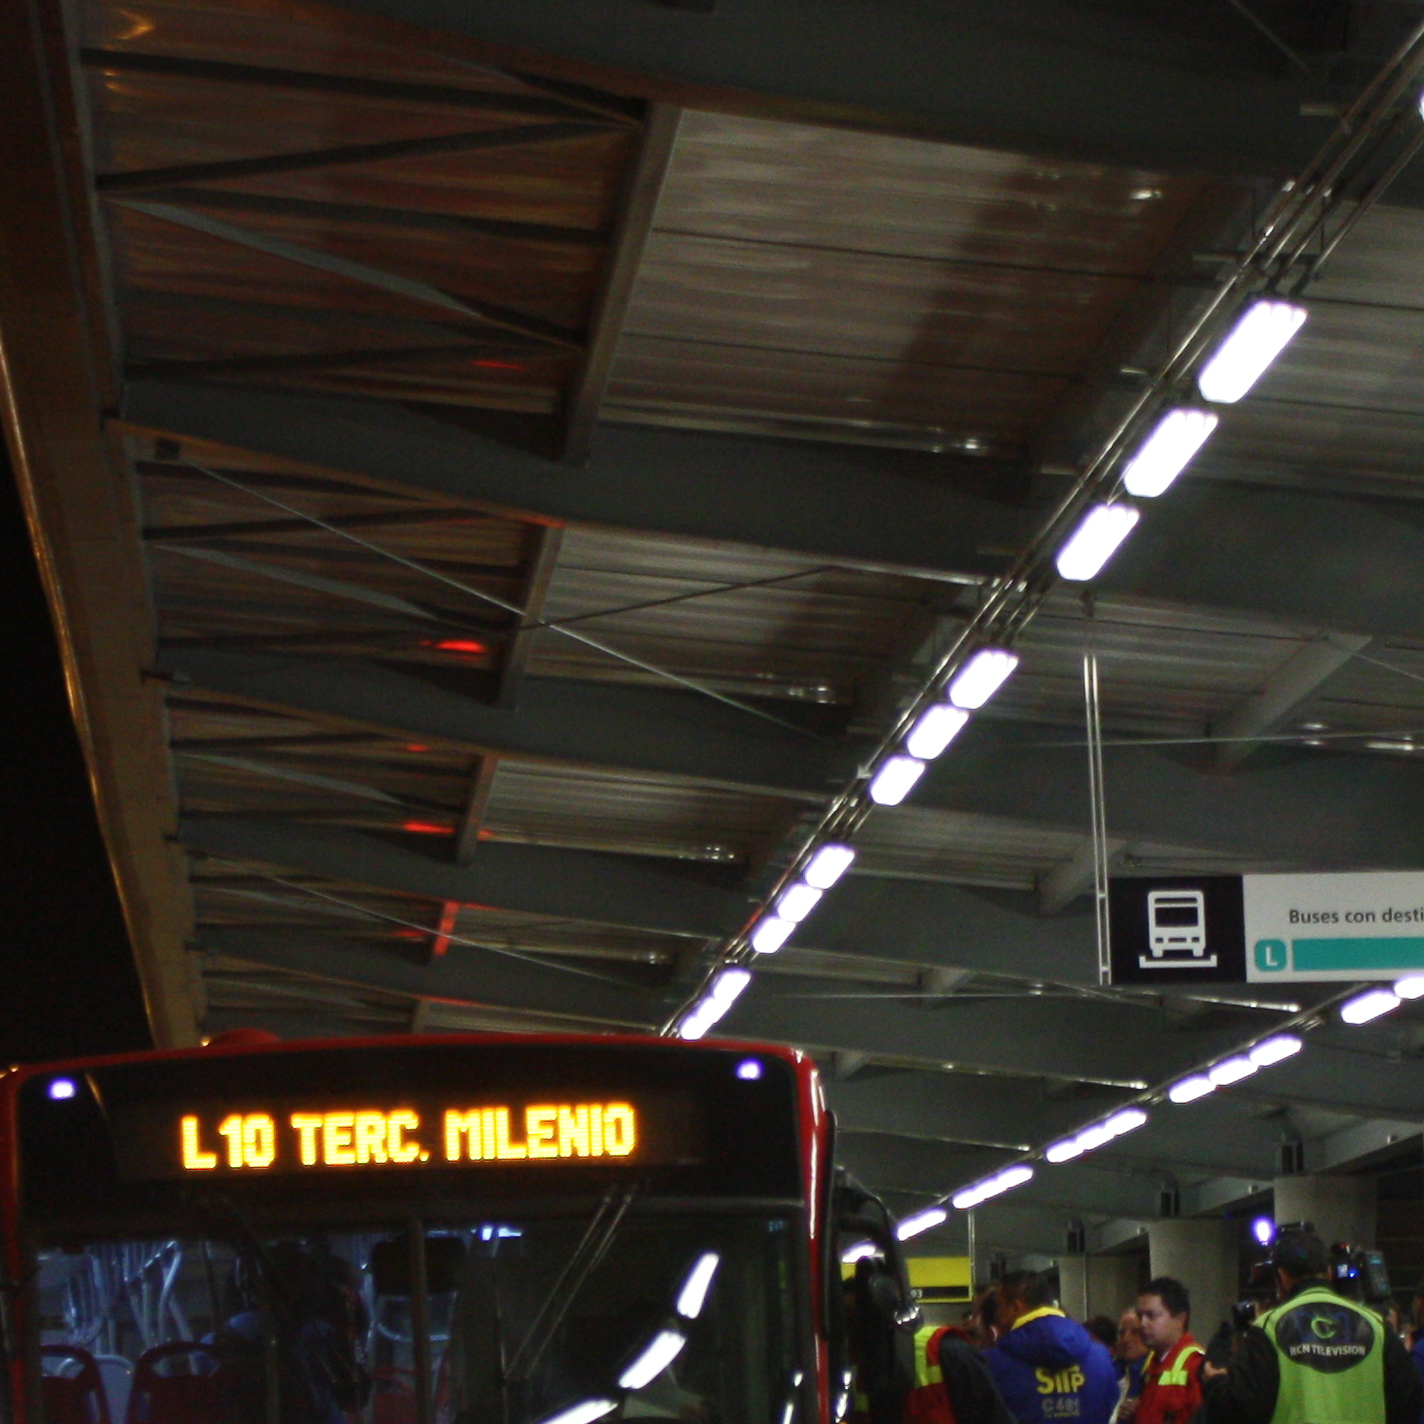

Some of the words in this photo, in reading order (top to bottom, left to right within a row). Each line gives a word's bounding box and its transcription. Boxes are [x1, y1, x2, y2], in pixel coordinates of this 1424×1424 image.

[1289, 909, 1339, 924] Buses
[1345, 910, 1376, 924] con
[1265, 946, 1278, 967] L
[181, 1114, 276, 1170] L10
[290, 1108, 430, 1168] TERC.
[444, 1102, 637, 1162] MILENIO
[1311, 1343, 1366, 1357] TELEVISION
